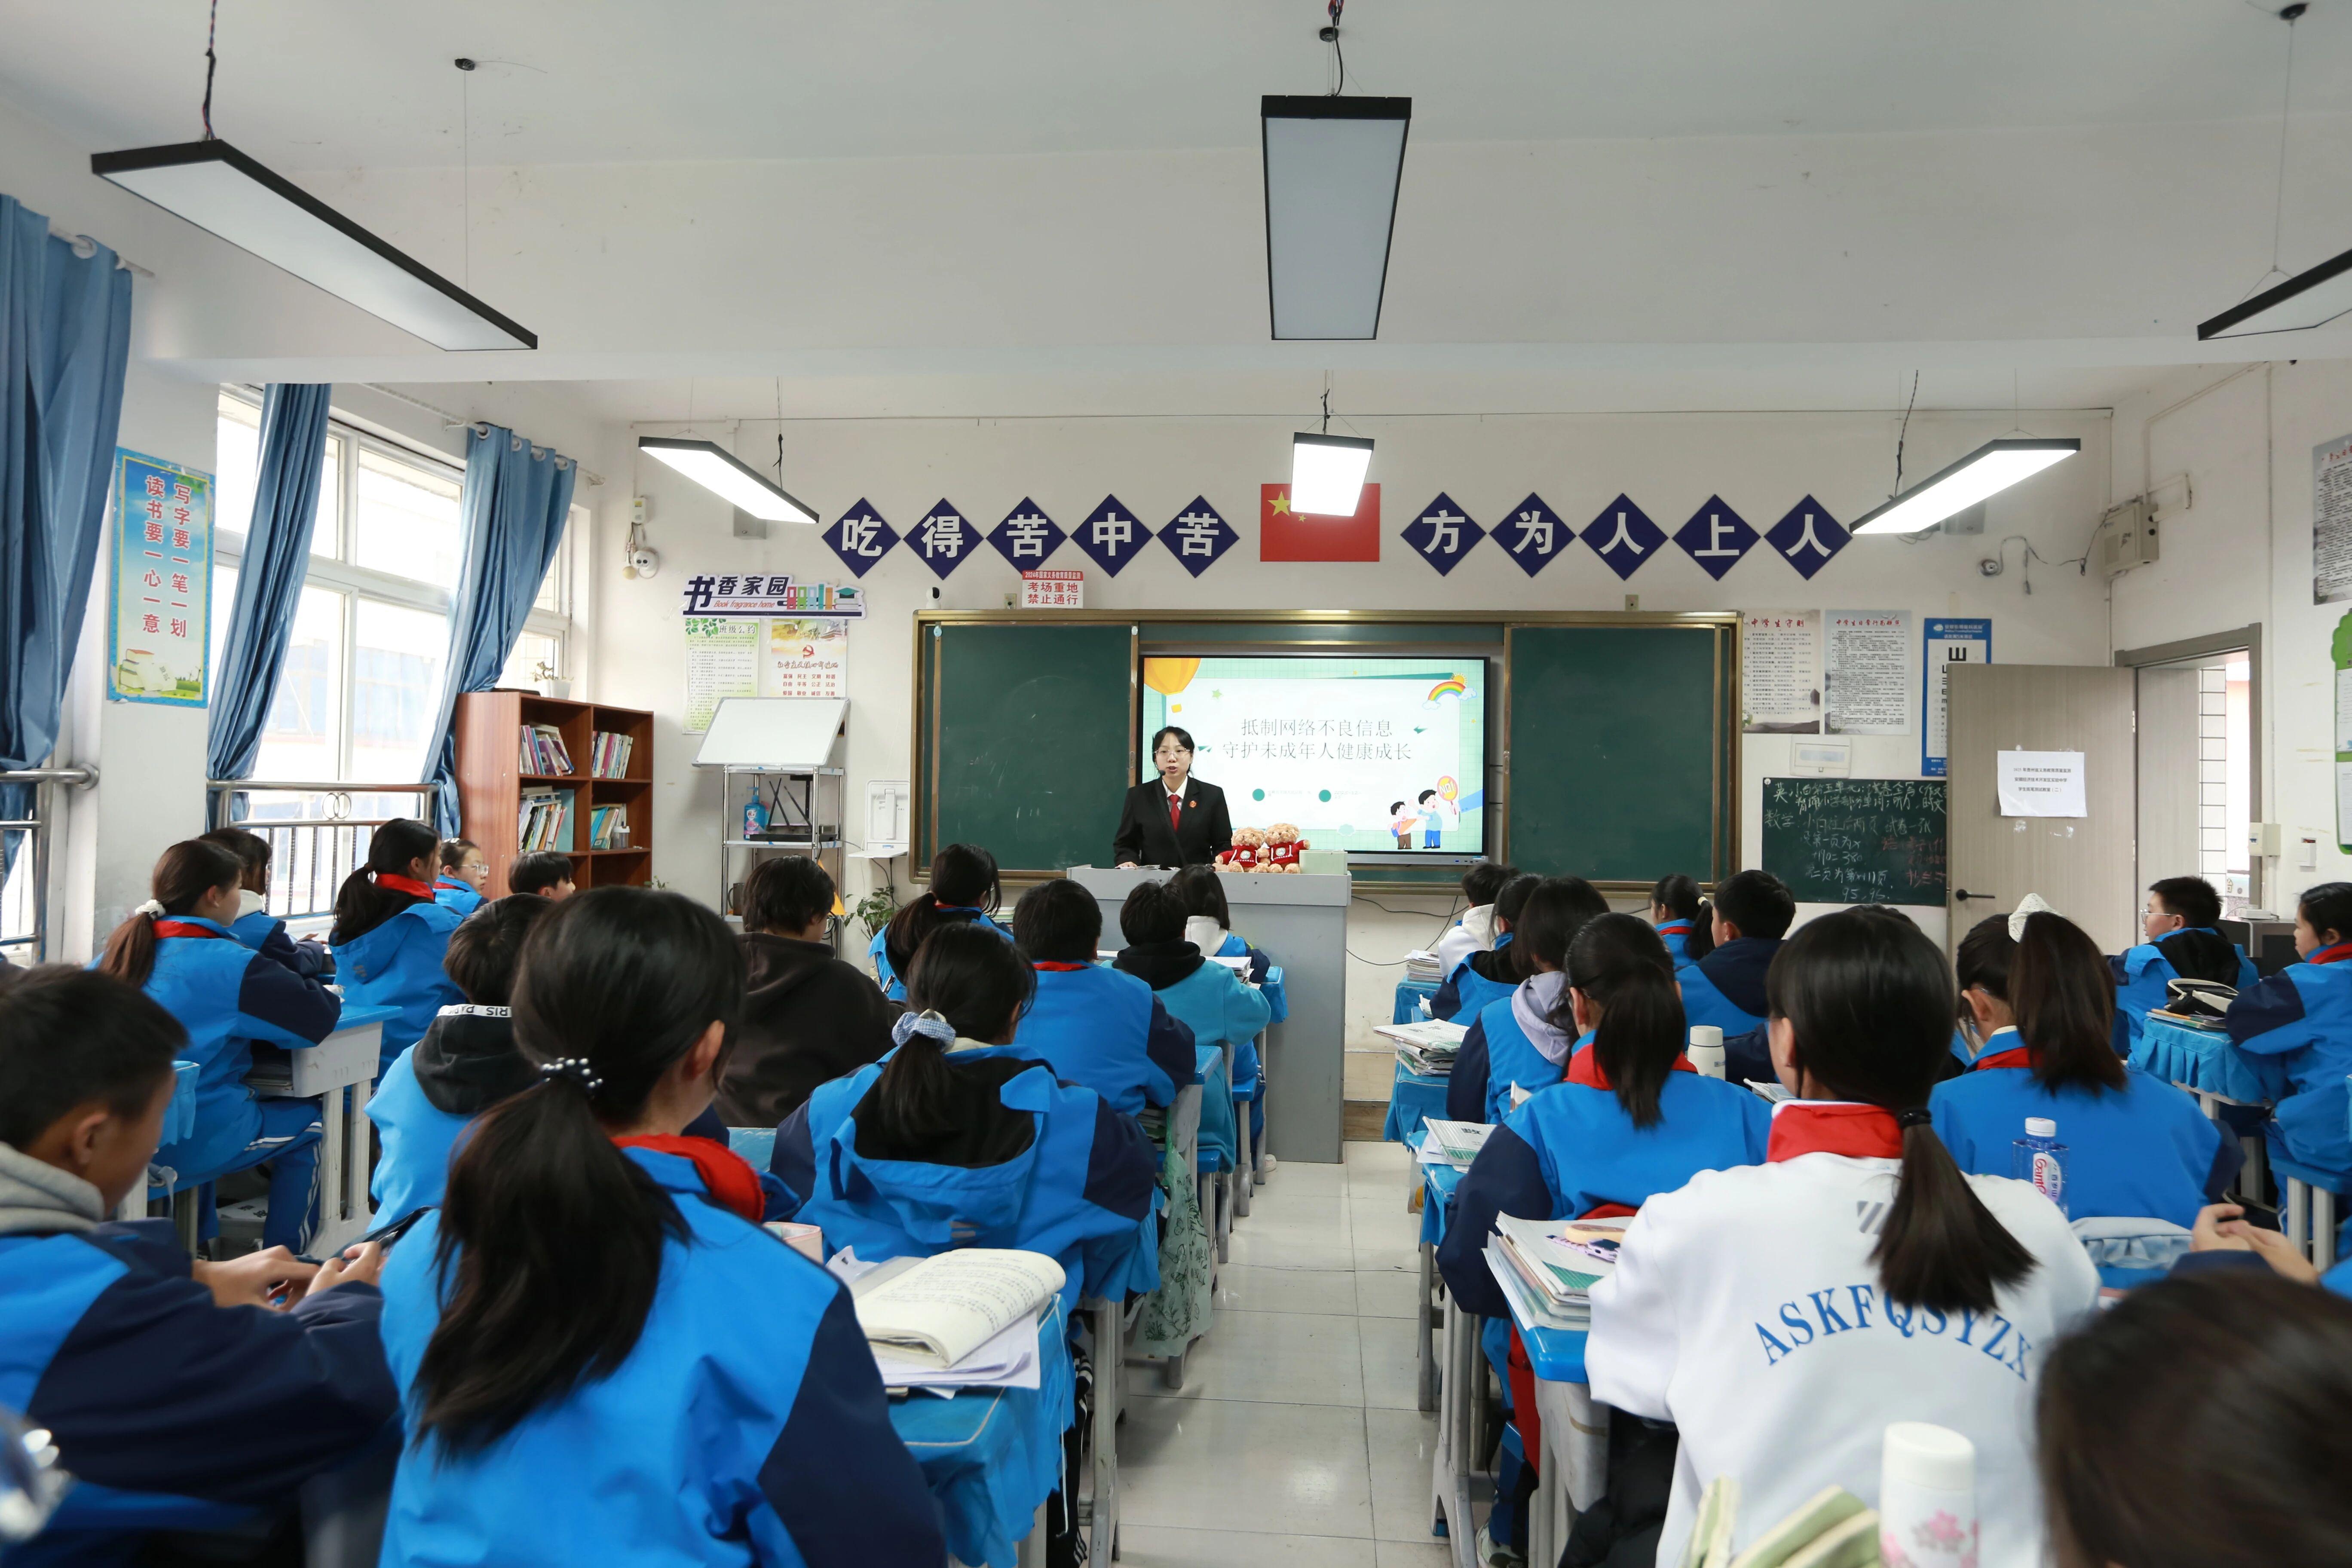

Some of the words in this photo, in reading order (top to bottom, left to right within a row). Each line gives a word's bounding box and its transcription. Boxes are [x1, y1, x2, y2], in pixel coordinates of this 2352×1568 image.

[841, 512, 1219, 558] 吃得苦中苦
[1422, 510, 1831, 557] 方为人上人
[143, 476, 165, 634] 读书要一心一意
[170, 483, 190, 638] 写字要一笔一划
[684, 576, 789, 611] 书香家园
[1028, 582, 1078, 593] 考场重地
[730, 600, 757, 609] fragrance
[1028, 594, 1078, 605] 禁止通行
[719, 625, 756, 634] 班级公约
[1751, 618, 1804, 628] 中学生守则
[1241, 719, 1392, 737] 抵制网络不良信息
[1222, 741, 1412, 760] 守护未成年人健康成长
[486, 1007, 509, 1016] RIS
